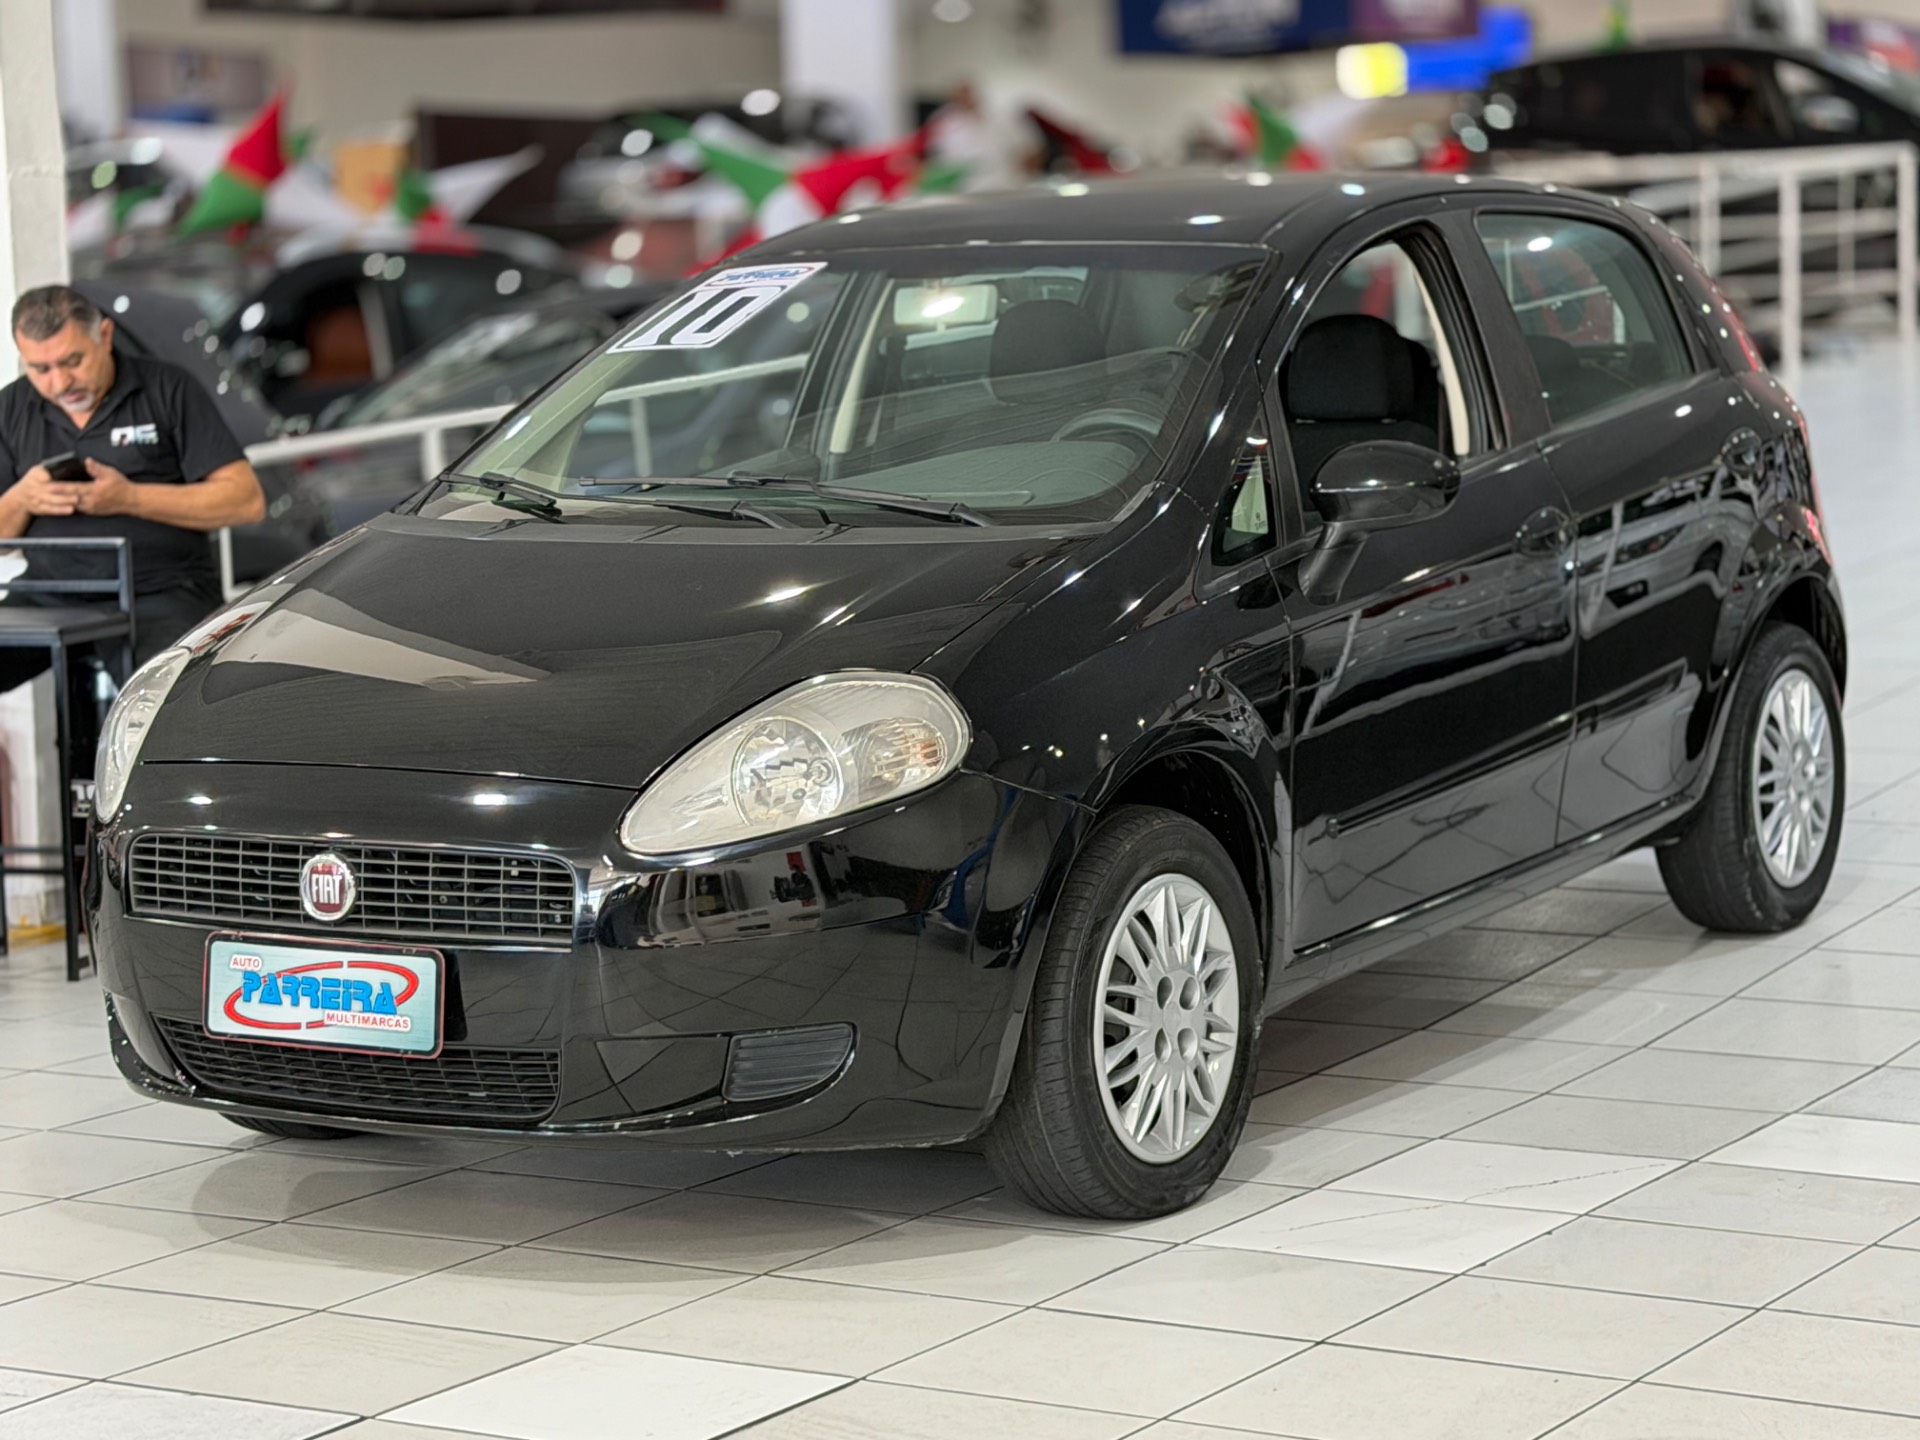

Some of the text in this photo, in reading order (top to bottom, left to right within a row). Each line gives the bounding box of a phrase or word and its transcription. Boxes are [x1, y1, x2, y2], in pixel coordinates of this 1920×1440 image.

[622, 286, 782, 346] 10
[312, 873, 342, 904] FIAT
[232, 957, 260, 969] AUTO
[242, 971, 397, 1014] PARREIRA
[326, 1012, 409, 1028] MULTIMARCAS
